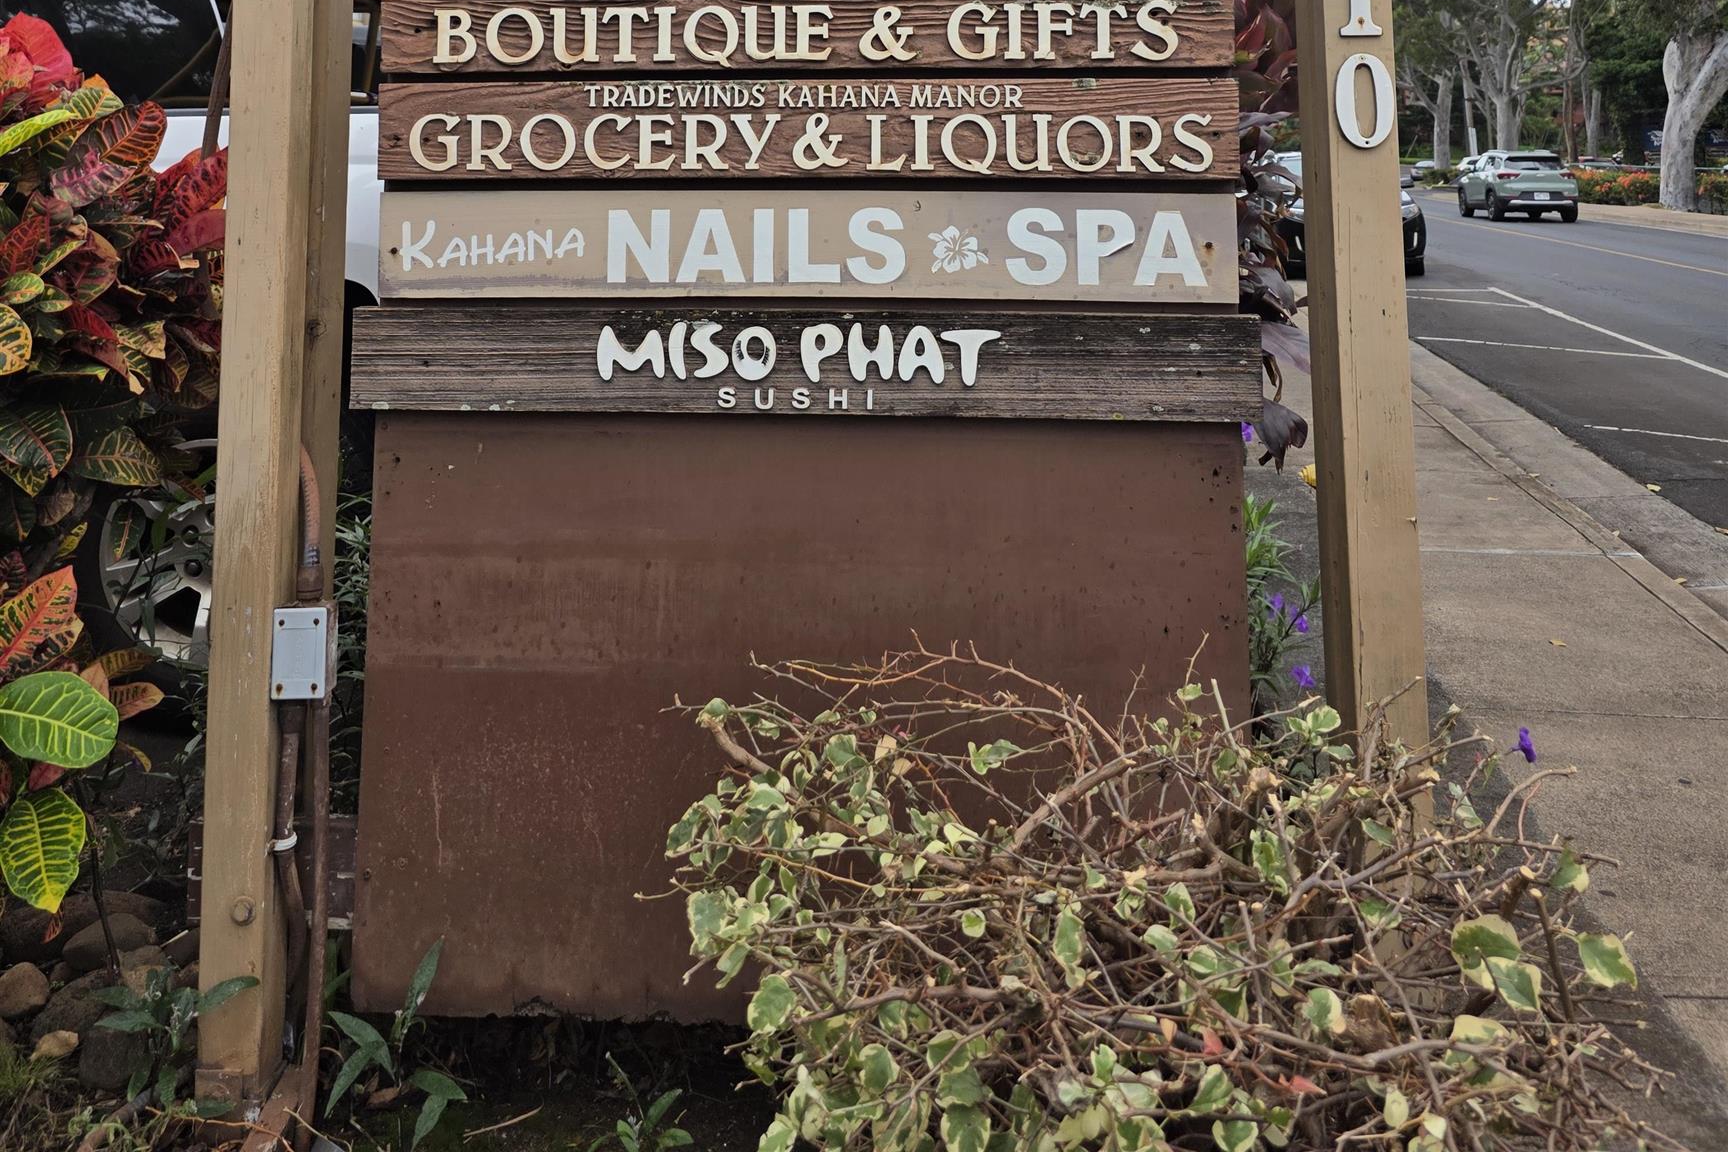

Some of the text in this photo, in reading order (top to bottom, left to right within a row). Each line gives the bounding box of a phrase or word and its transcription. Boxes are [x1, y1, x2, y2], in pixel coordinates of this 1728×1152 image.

[433, 0, 1180, 67] BOUTIQUE & GIFTS
[584, 85, 1023, 108] TRADEWINDS KAHANA MANOR
[408, 112, 1213, 175] GROCERY & LIQUORS
[400, 207, 1208, 288] KAHANA NAILS SPA
[596, 322, 1001, 386] MISO PHAT
[717, 387, 873, 410] SUSHI
